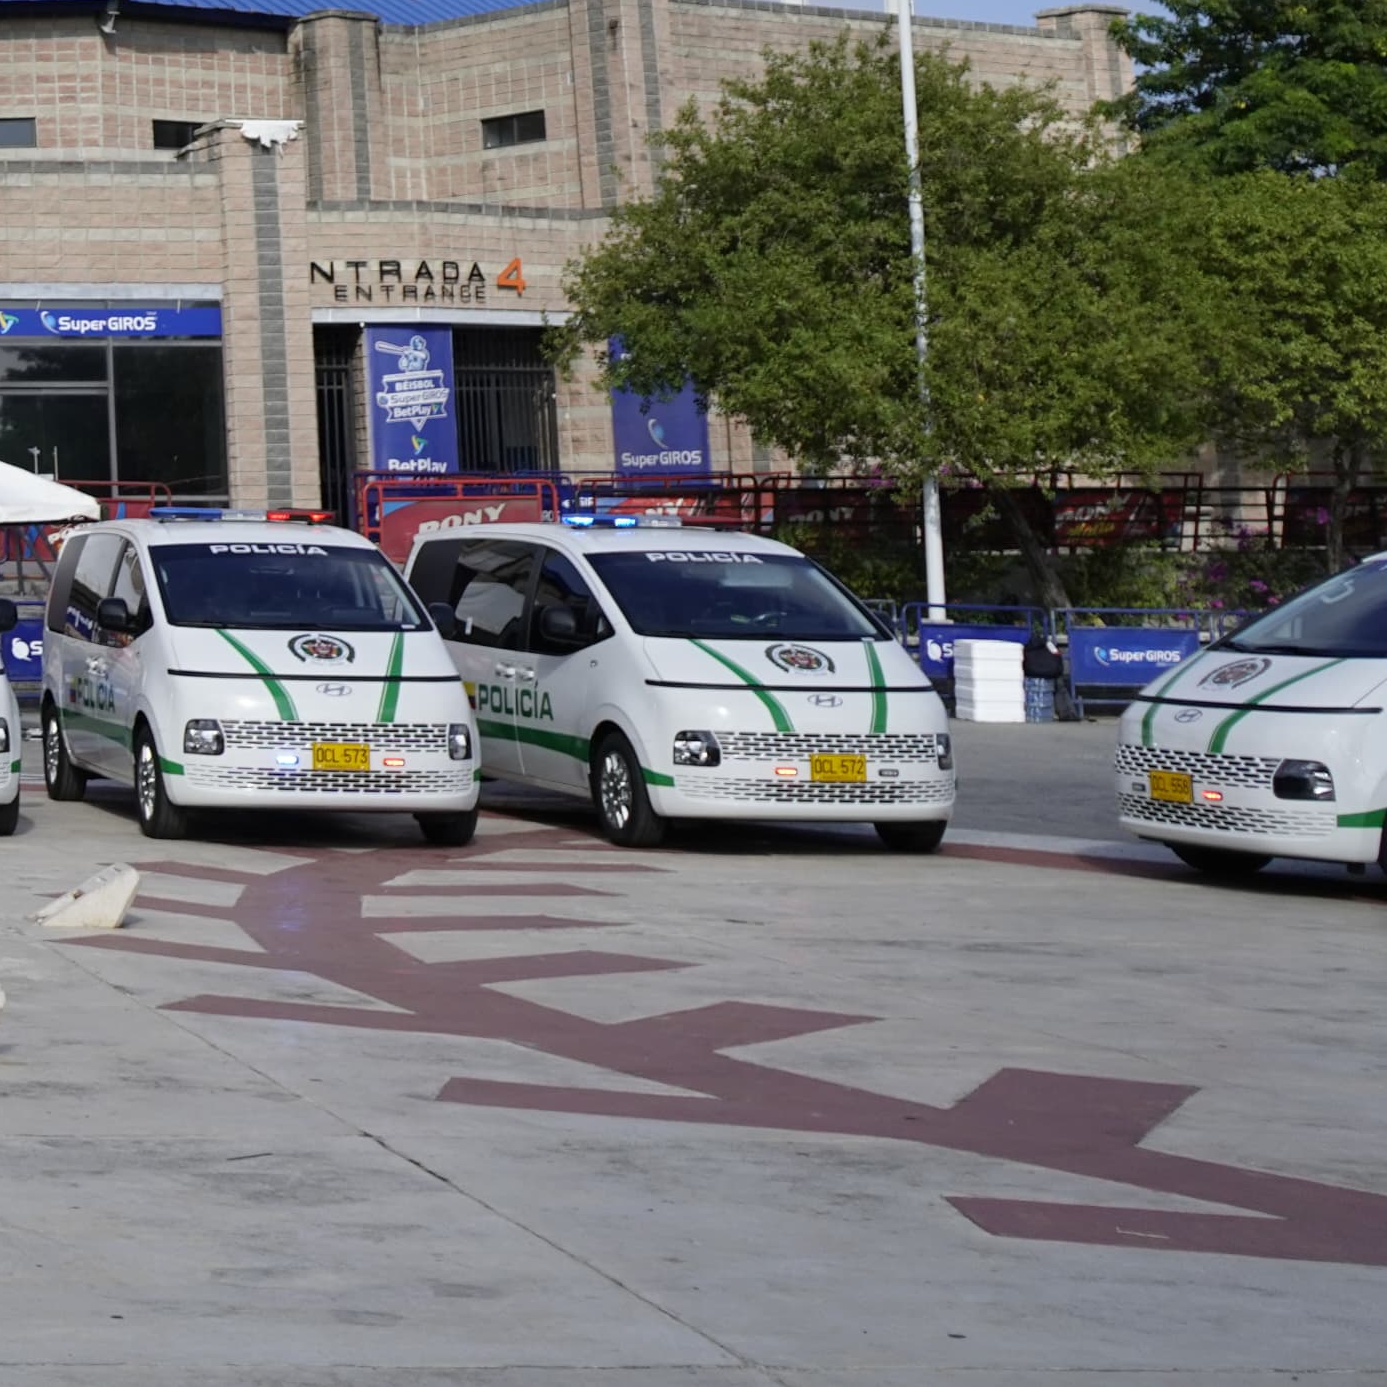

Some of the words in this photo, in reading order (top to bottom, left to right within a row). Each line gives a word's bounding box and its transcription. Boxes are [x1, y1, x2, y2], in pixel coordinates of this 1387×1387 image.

[310, 260, 485, 285] NTRADA
[496, 257, 527, 299] 4
[335, 285, 486, 304] ENTRANCE
[209, 543, 329, 557] POLICÍA
[644, 552, 764, 565] POLICÍA
[478, 678, 555, 721] POLICÍA
